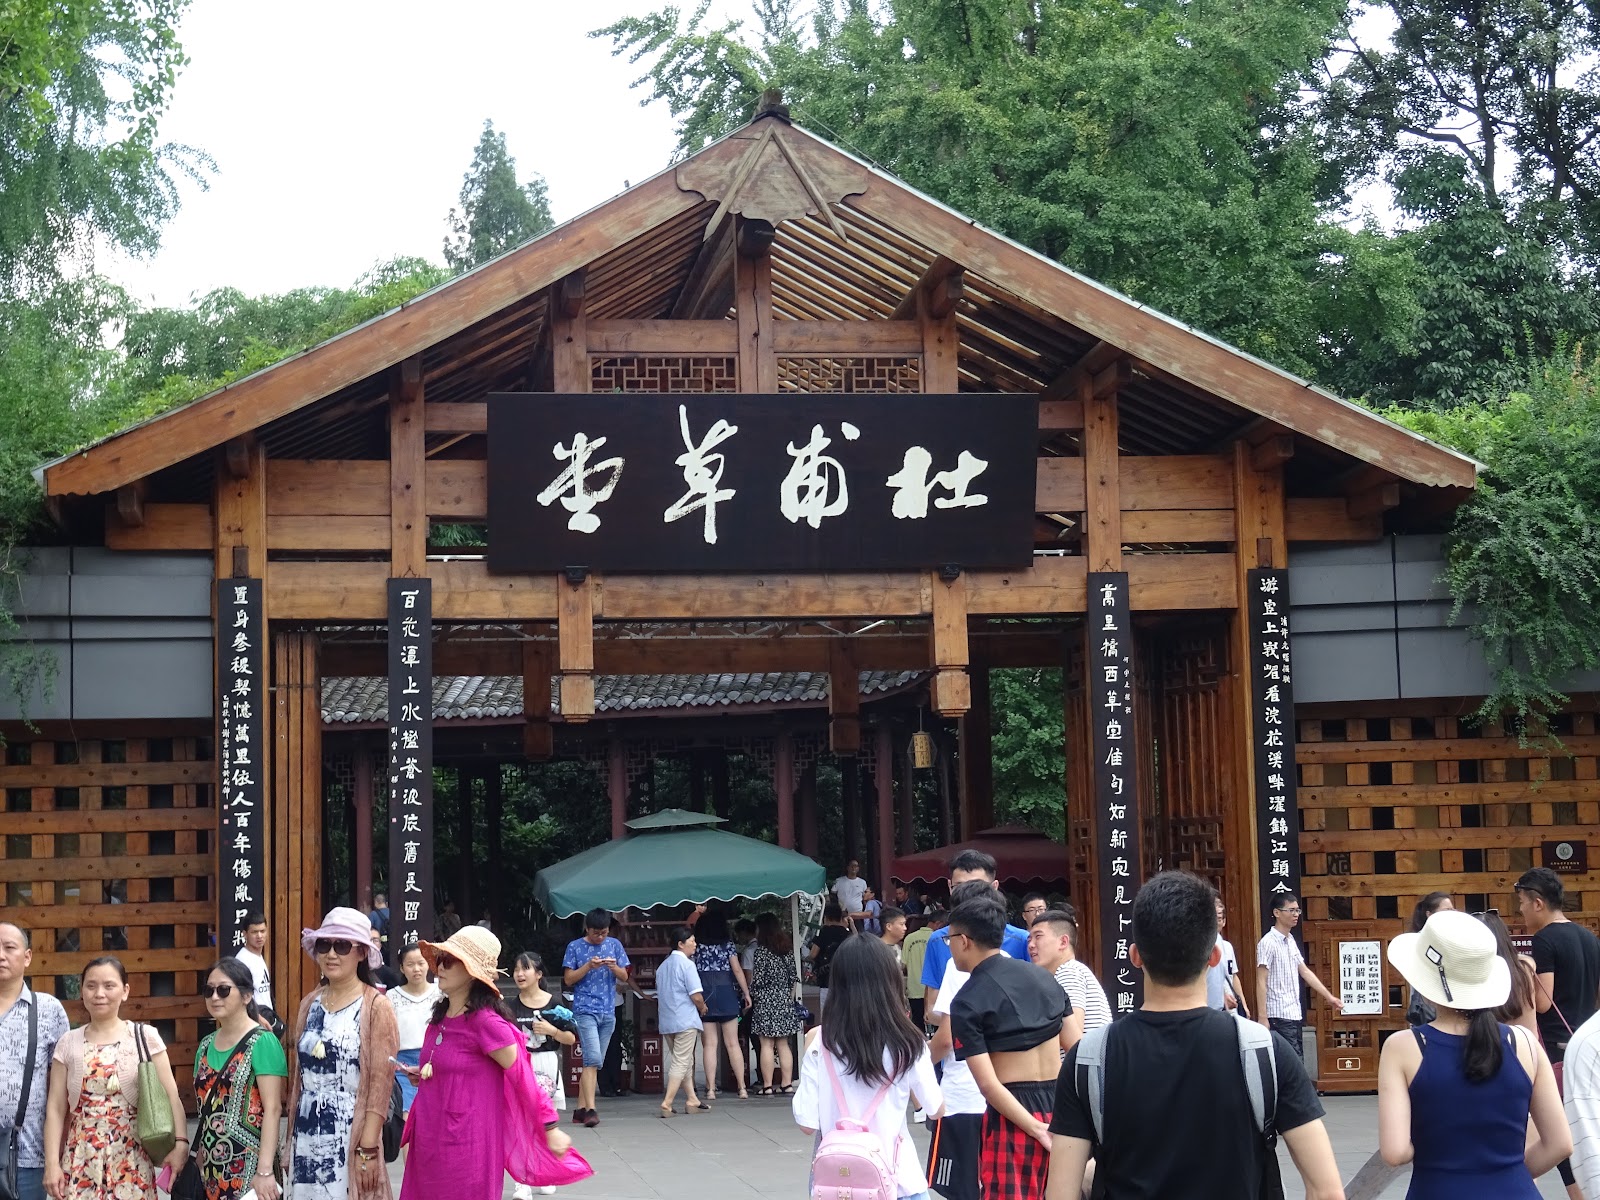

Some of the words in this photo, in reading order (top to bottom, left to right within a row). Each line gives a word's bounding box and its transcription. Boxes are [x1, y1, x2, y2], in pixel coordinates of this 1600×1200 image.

[536, 404, 989, 545] 杜甫草堂
[1342, 954, 1353, 1003] 预订取票
[1355, 954, 1366, 1003] 讲解服务
[643, 1065, 660, 1073] 入口
